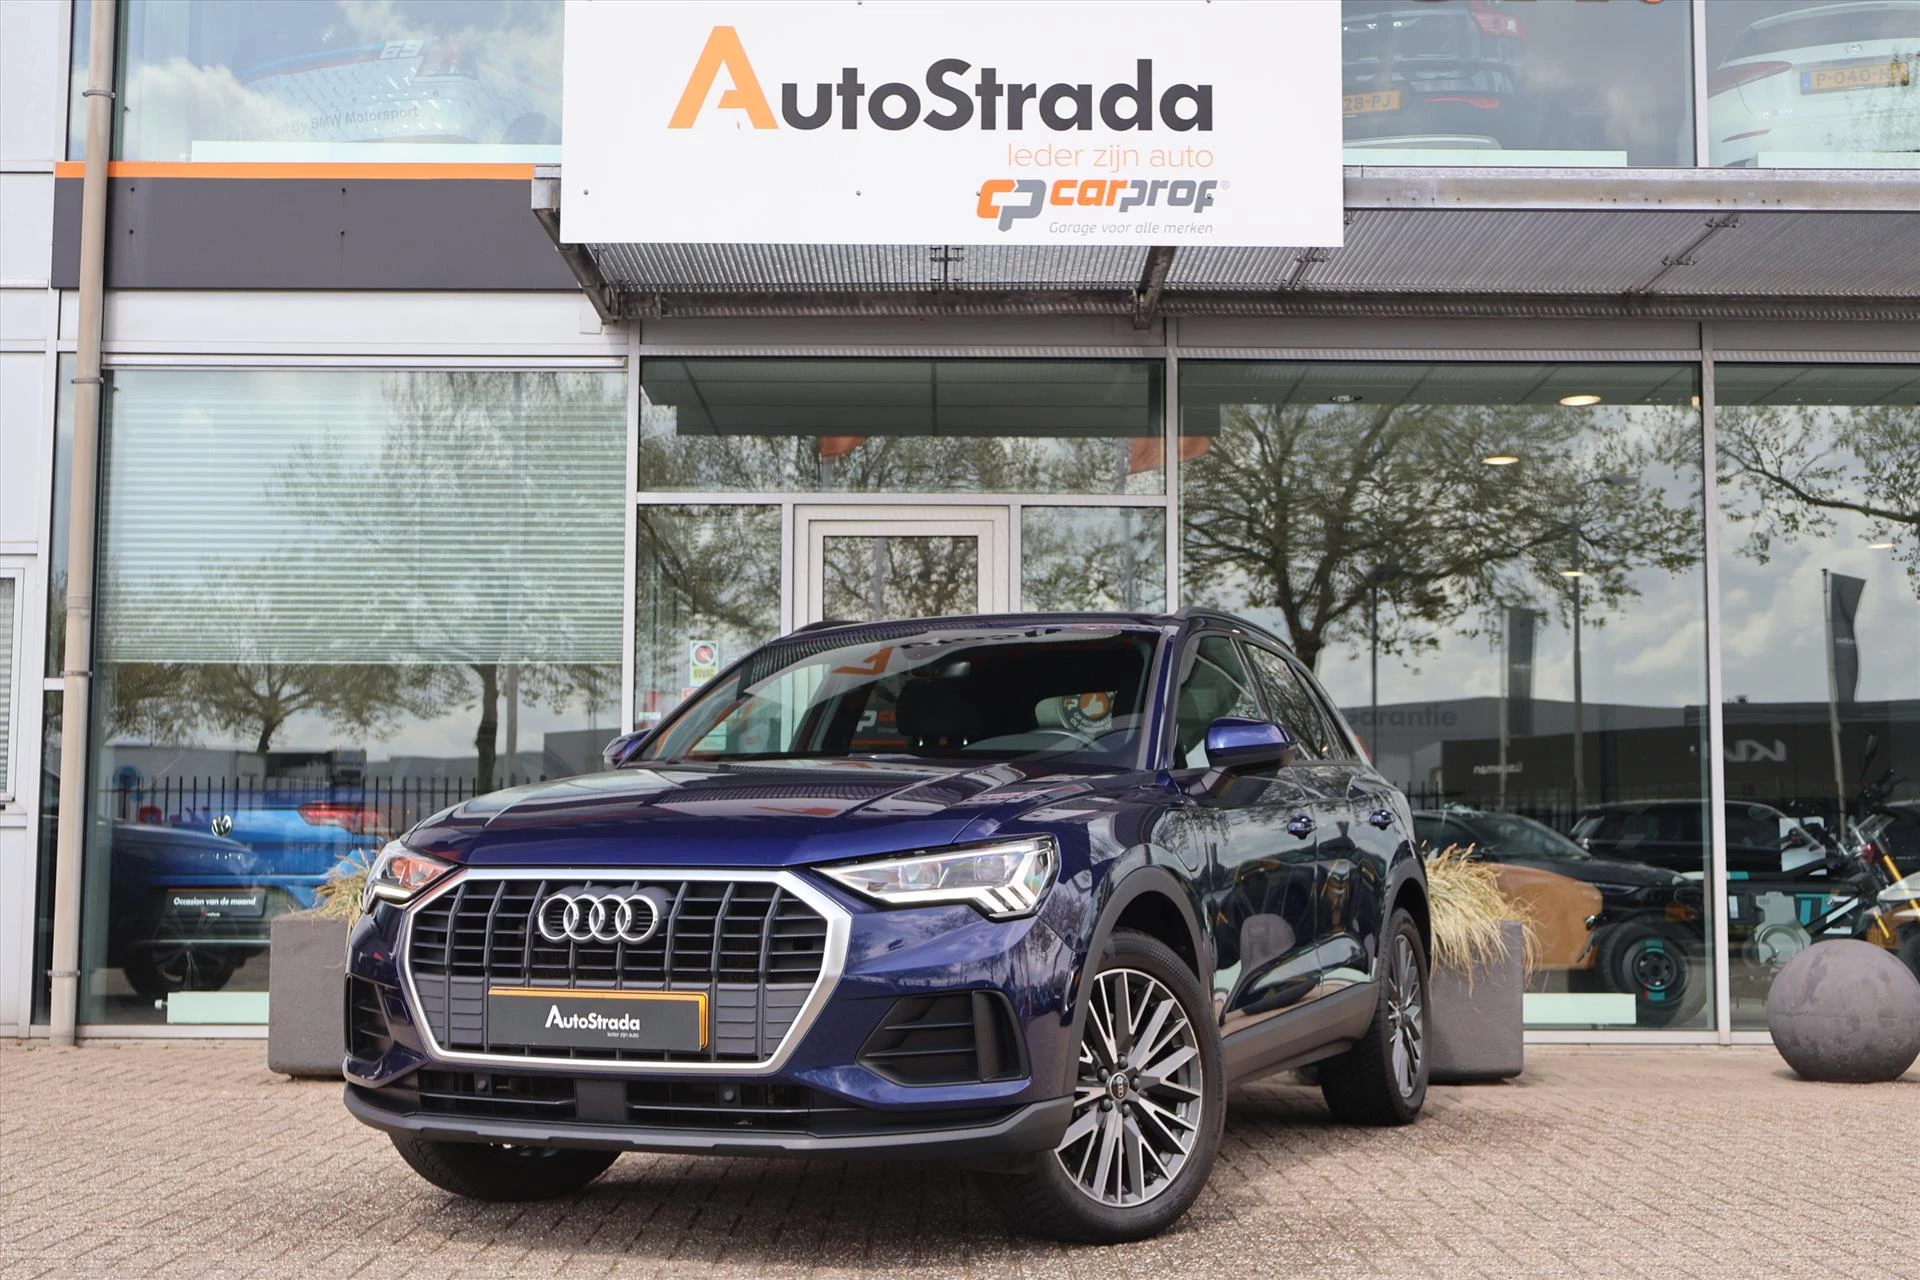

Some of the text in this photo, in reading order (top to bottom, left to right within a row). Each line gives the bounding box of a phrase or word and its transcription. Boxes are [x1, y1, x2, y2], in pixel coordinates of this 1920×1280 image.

[379, 40, 424, 60] 69
[667, 26, 1213, 131] AutoStrada
[292, 120, 306, 136] By
[311, 114, 341, 130] BMW
[345, 105, 418, 125] Motorsport
[1008, 143, 1214, 173] Ieder zijn auto
[1049, 221, 1213, 236] Garage voor alle merken
[173, 896, 257, 906] Occasion van de maand
[545, 1004, 641, 1031] AutoStrada
